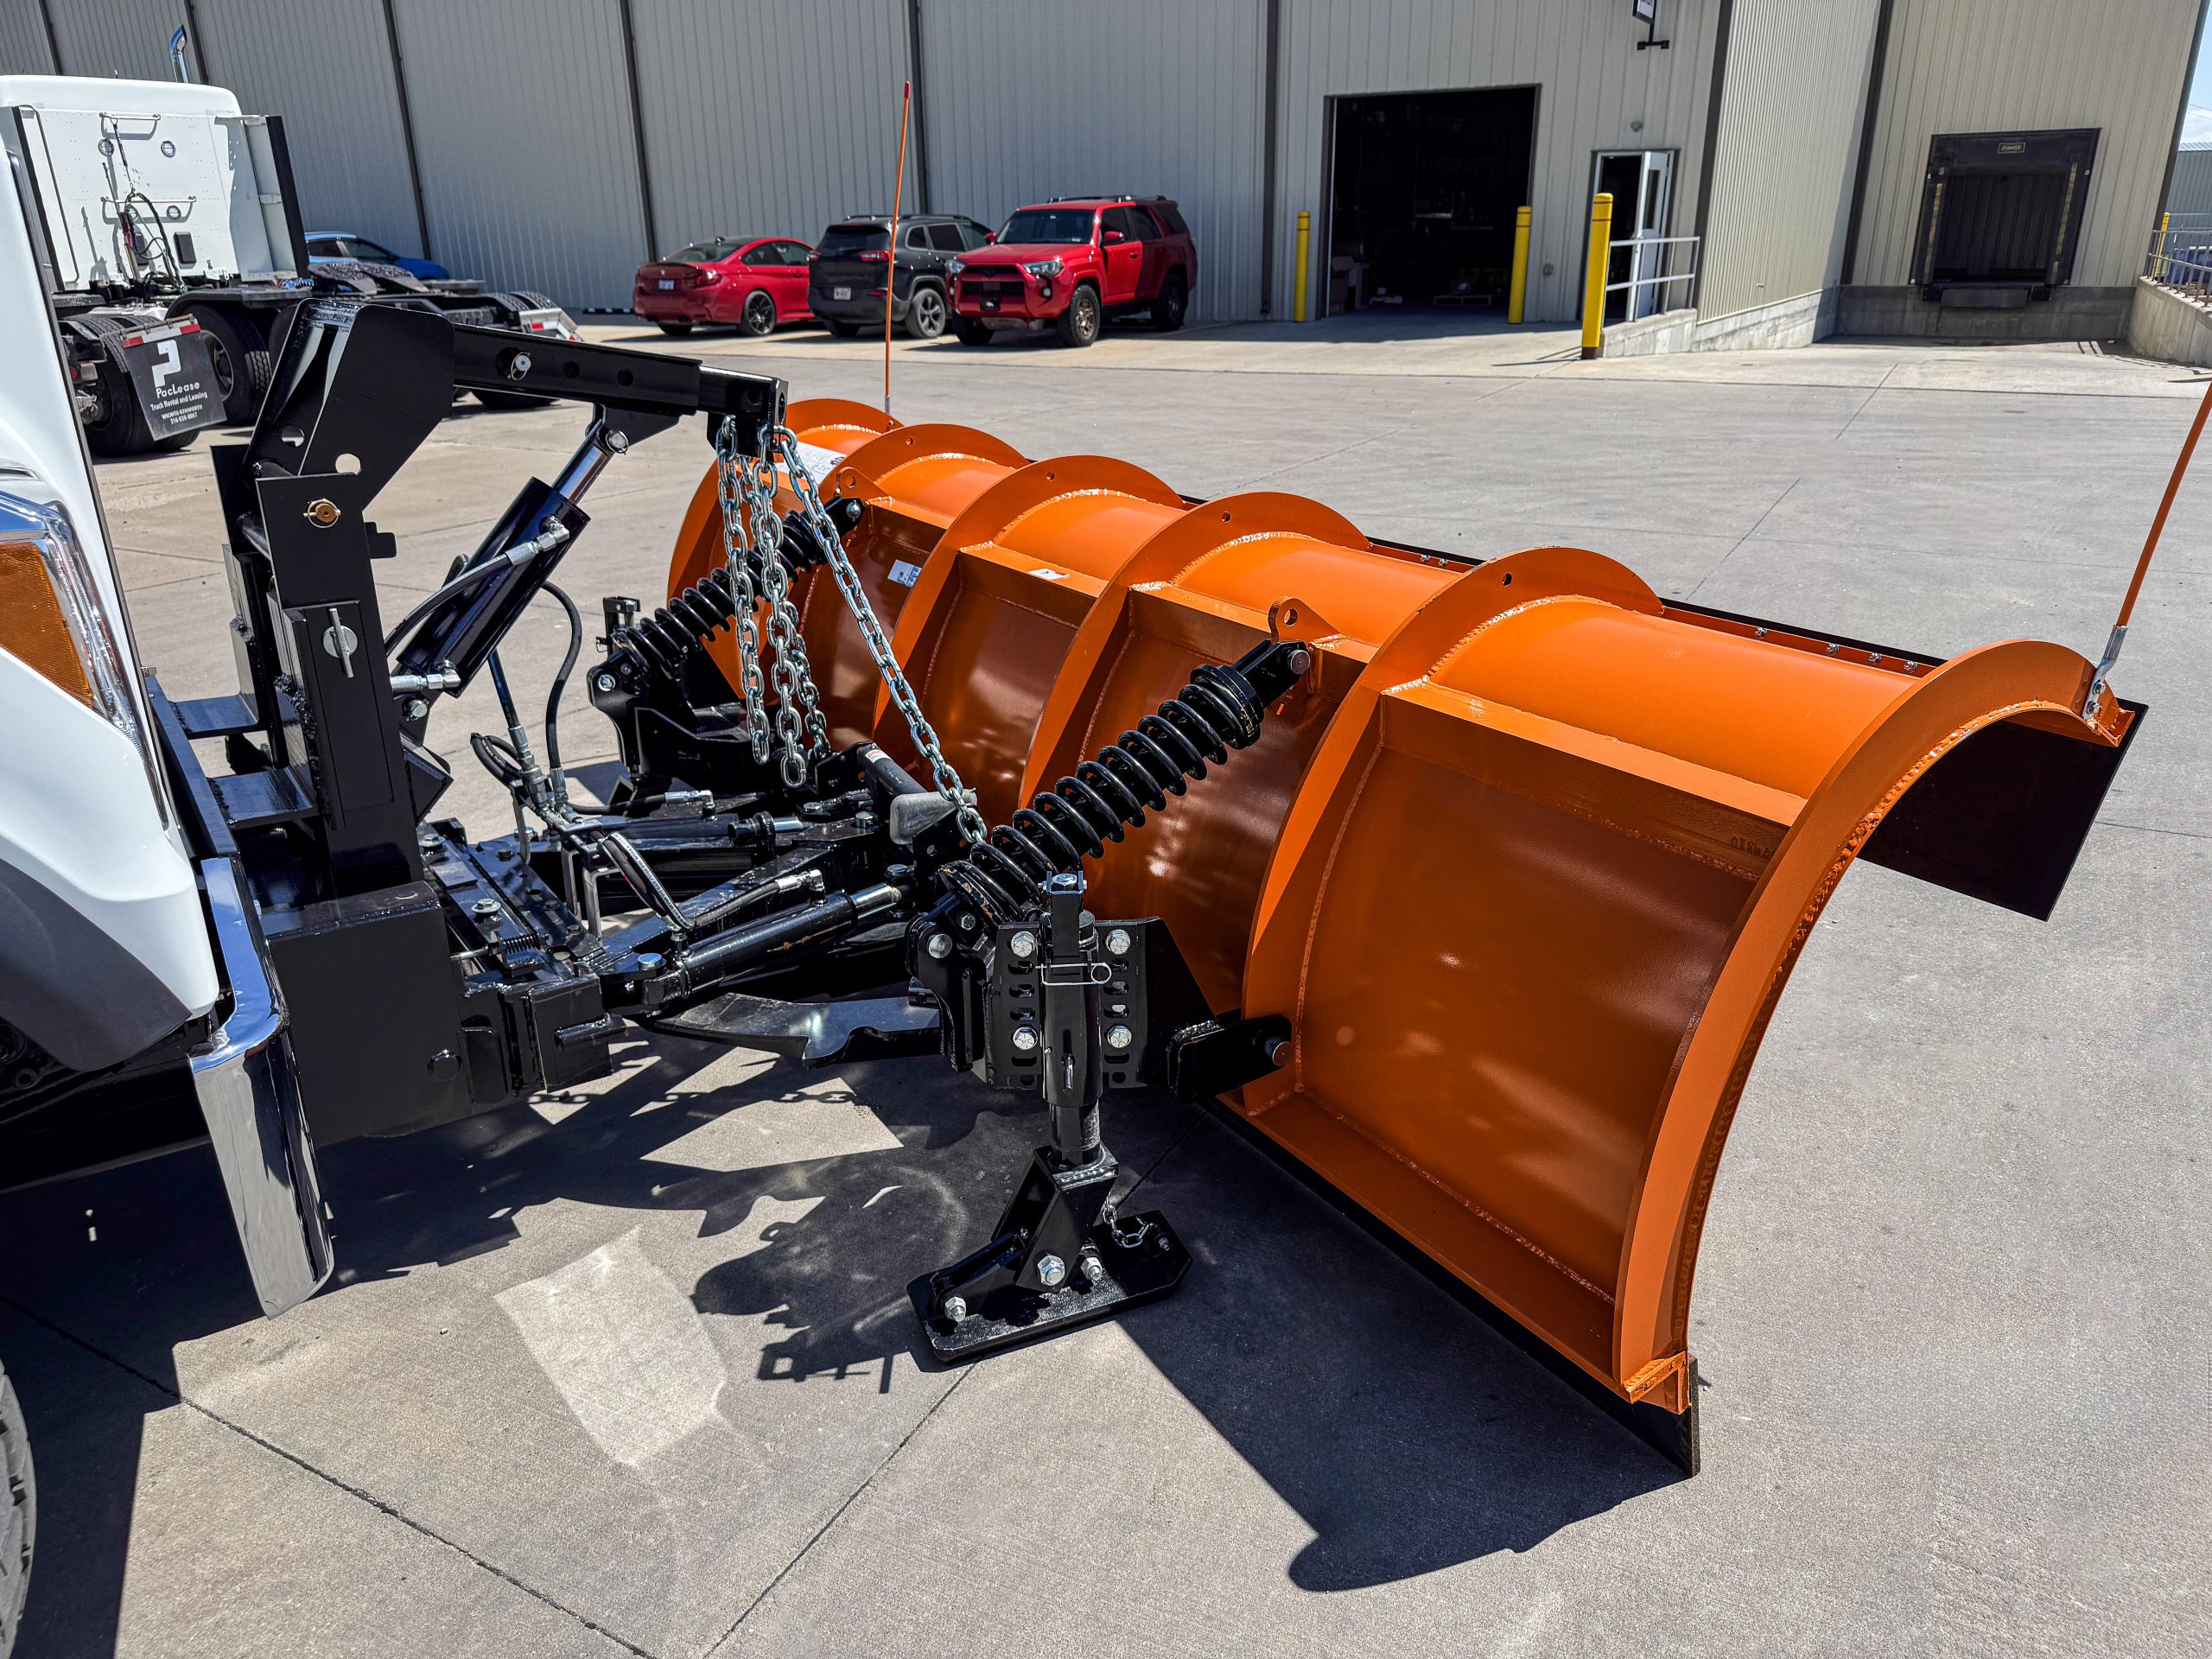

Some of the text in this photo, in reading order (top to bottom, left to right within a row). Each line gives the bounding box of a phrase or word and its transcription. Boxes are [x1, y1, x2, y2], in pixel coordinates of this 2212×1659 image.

[156, 382, 200, 398] PacLease
[150, 391, 207, 411] Truck Rental and Leasing
[162, 404, 203, 420] WICHITA KENWORTH
